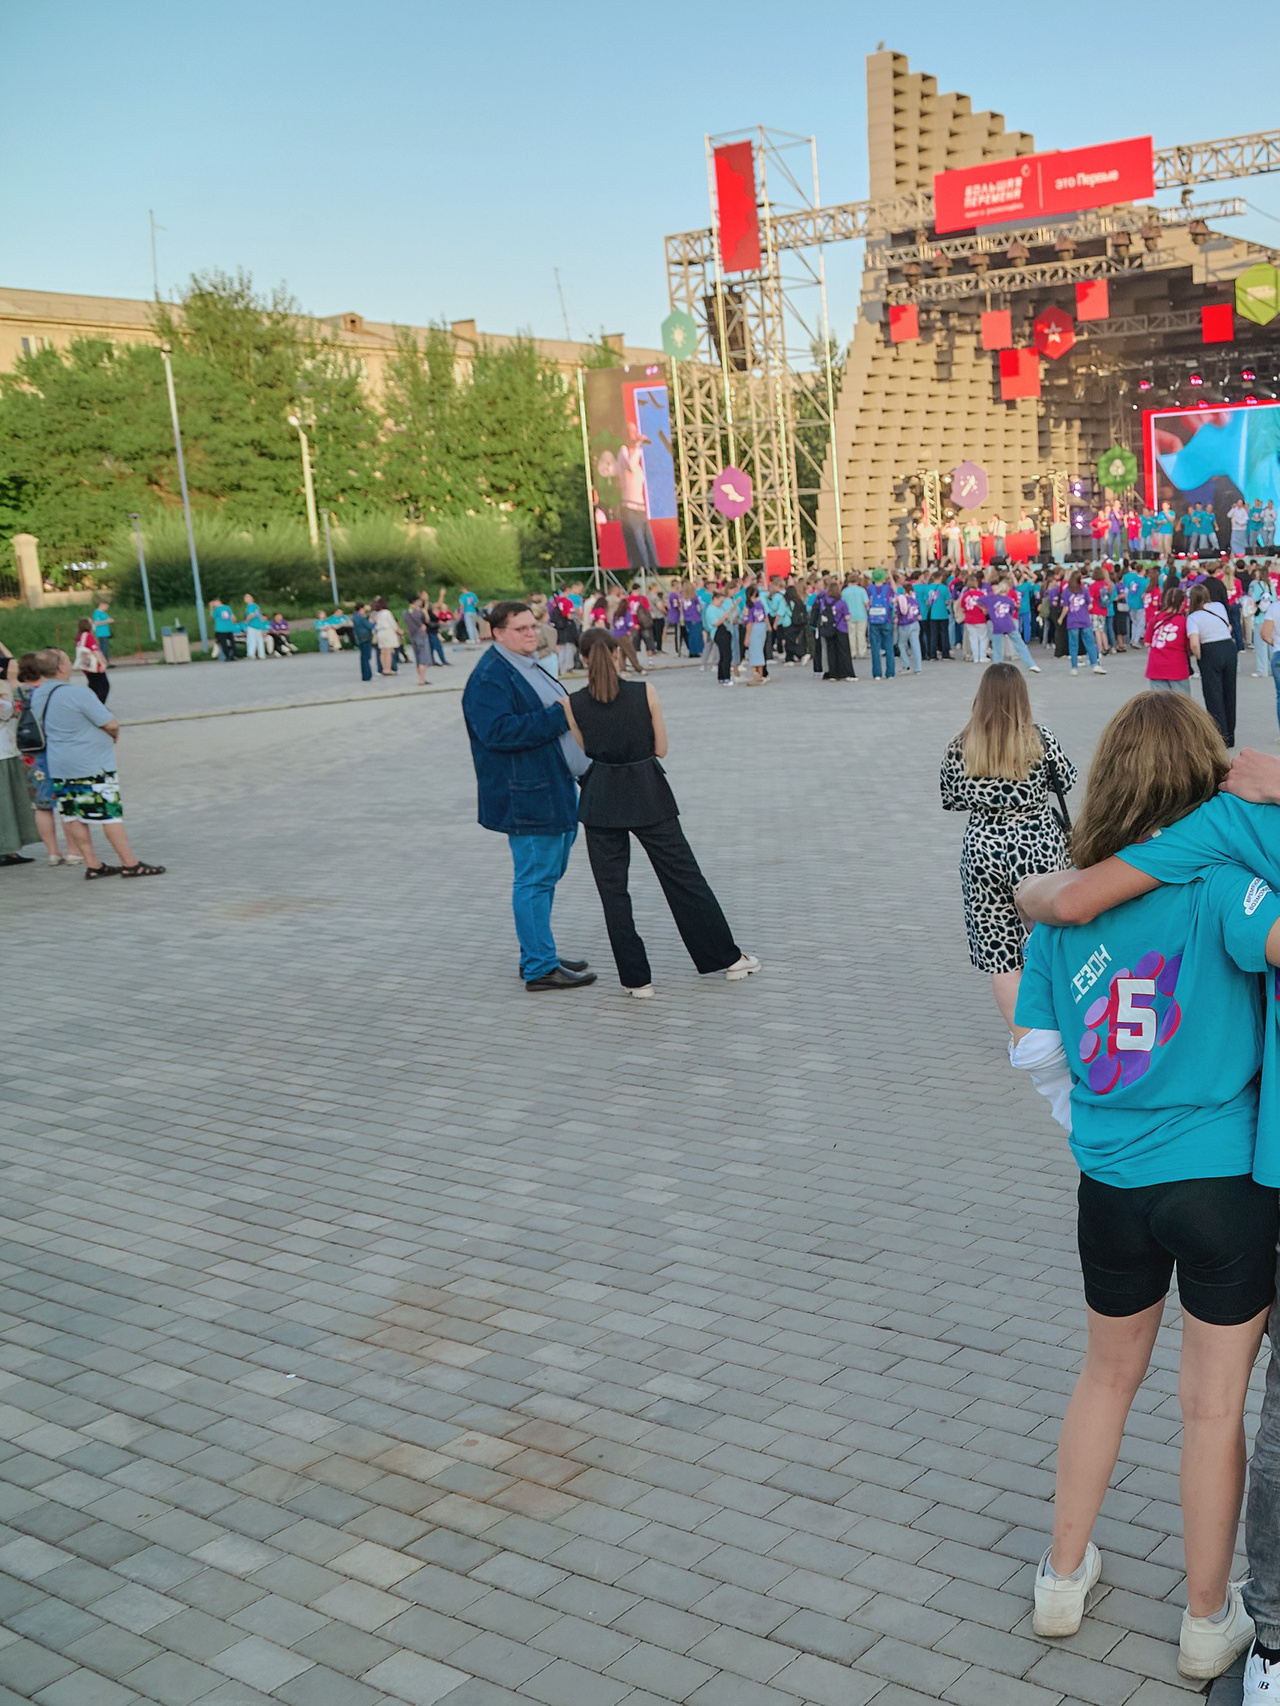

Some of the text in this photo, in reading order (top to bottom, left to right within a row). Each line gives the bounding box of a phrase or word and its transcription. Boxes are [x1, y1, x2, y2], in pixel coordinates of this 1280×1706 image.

[965, 175, 1023, 198] БОЛЬШАЯ
[1054, 169, 1119, 190] это Первые
[1114, 978, 1158, 1053] 5
